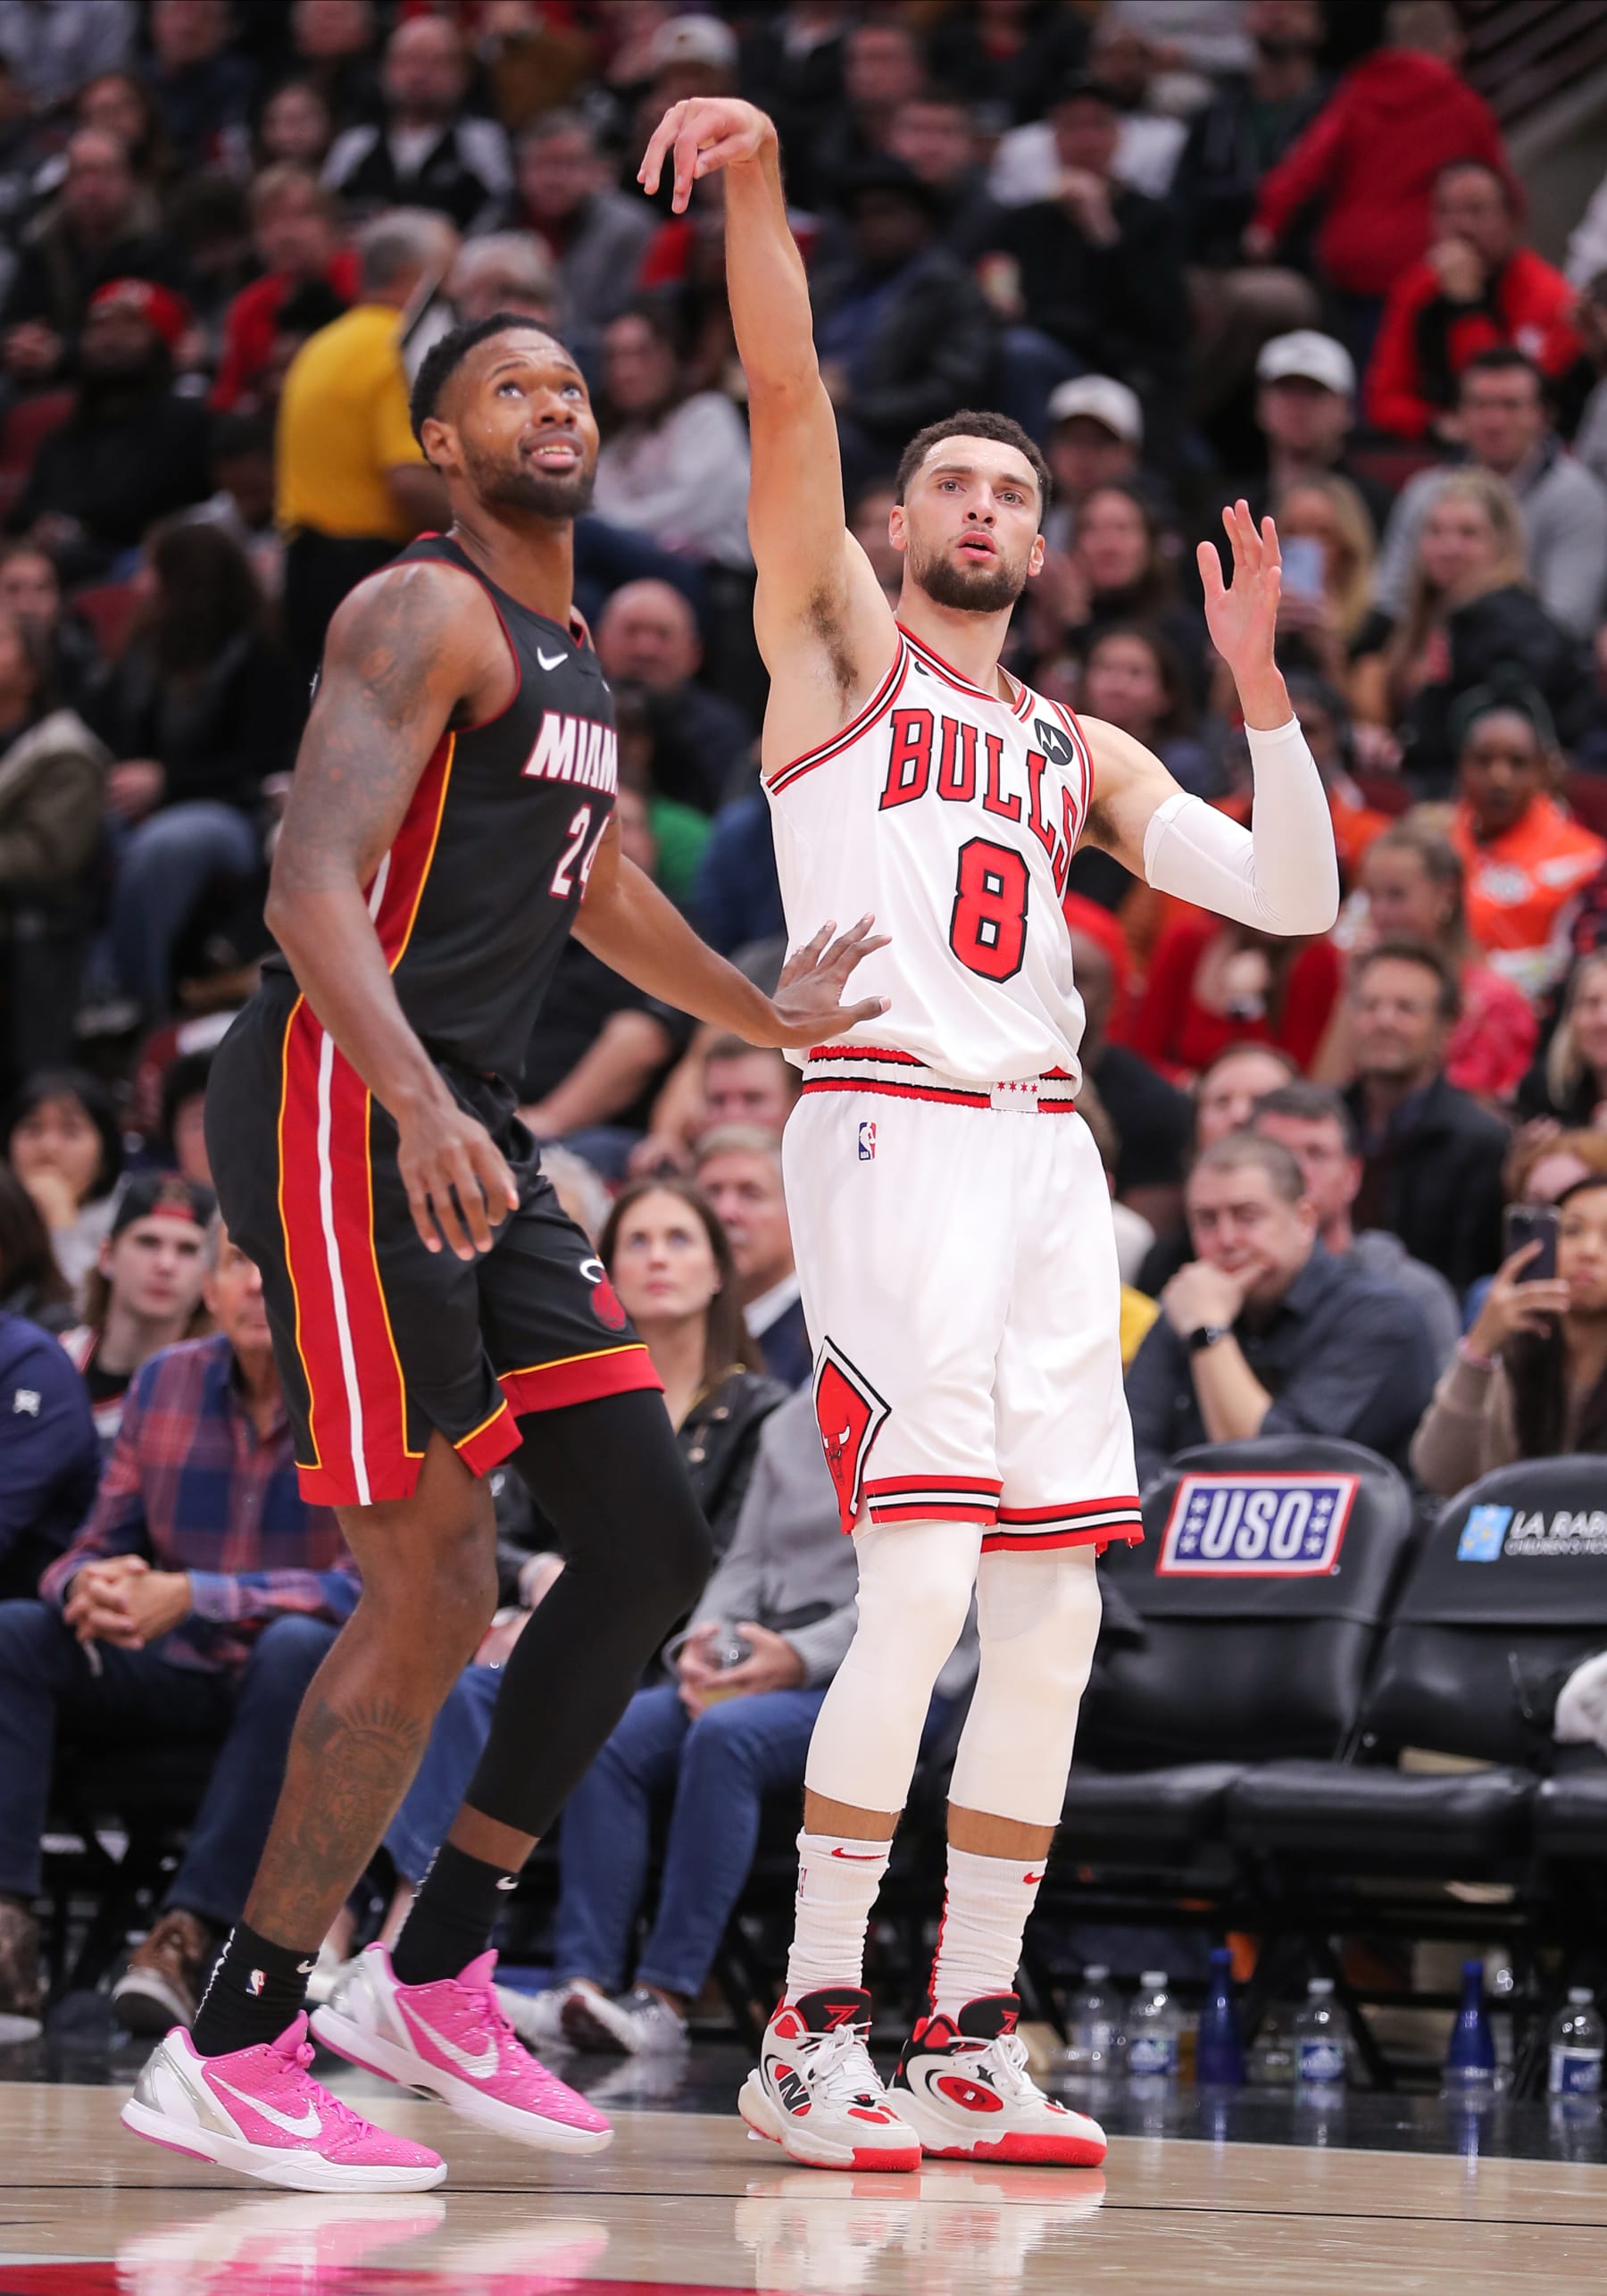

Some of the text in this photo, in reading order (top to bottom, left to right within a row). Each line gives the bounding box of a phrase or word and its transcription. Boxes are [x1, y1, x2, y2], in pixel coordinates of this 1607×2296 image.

[521, 709, 619, 797] MIAM
[878, 708, 1078, 898] BULLS
[949, 837, 1030, 984] 8
[1200, 1489, 1314, 1559] USO
[1510, 1511, 1545, 1539] LA
